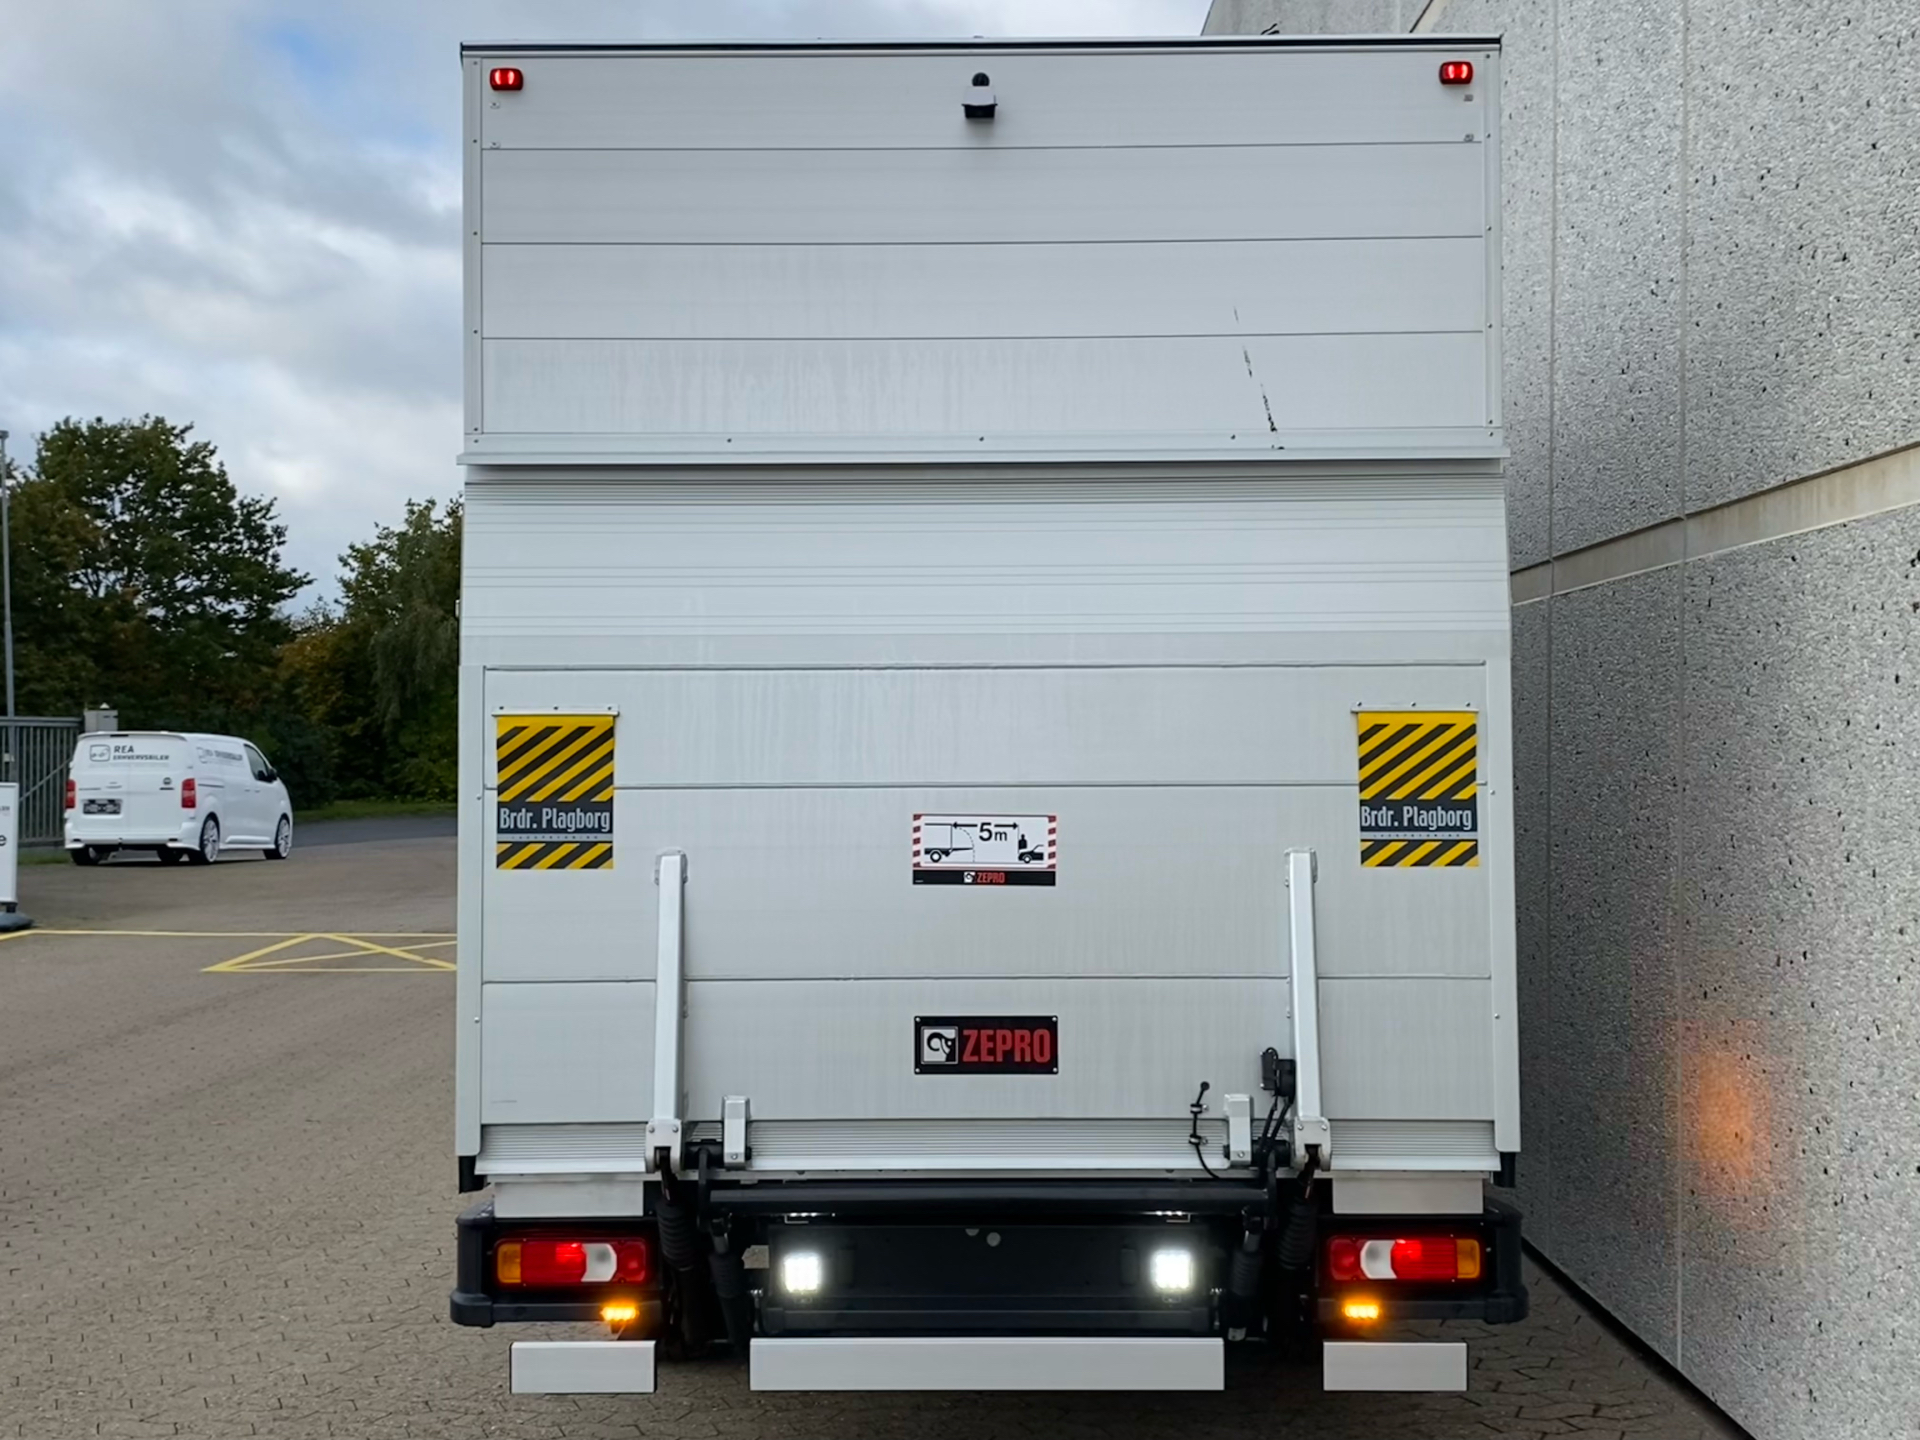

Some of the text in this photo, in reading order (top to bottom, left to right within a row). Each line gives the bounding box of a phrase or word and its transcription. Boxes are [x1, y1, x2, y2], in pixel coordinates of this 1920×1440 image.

[114, 745, 134, 753] REA
[500, 807, 610, 832] Brdr. Plagborg
[1361, 805, 1472, 830] Brdr. Plagborg
[977, 872, 1006, 884] ZEPRO
[962, 1028, 1051, 1063] ZEPRO
